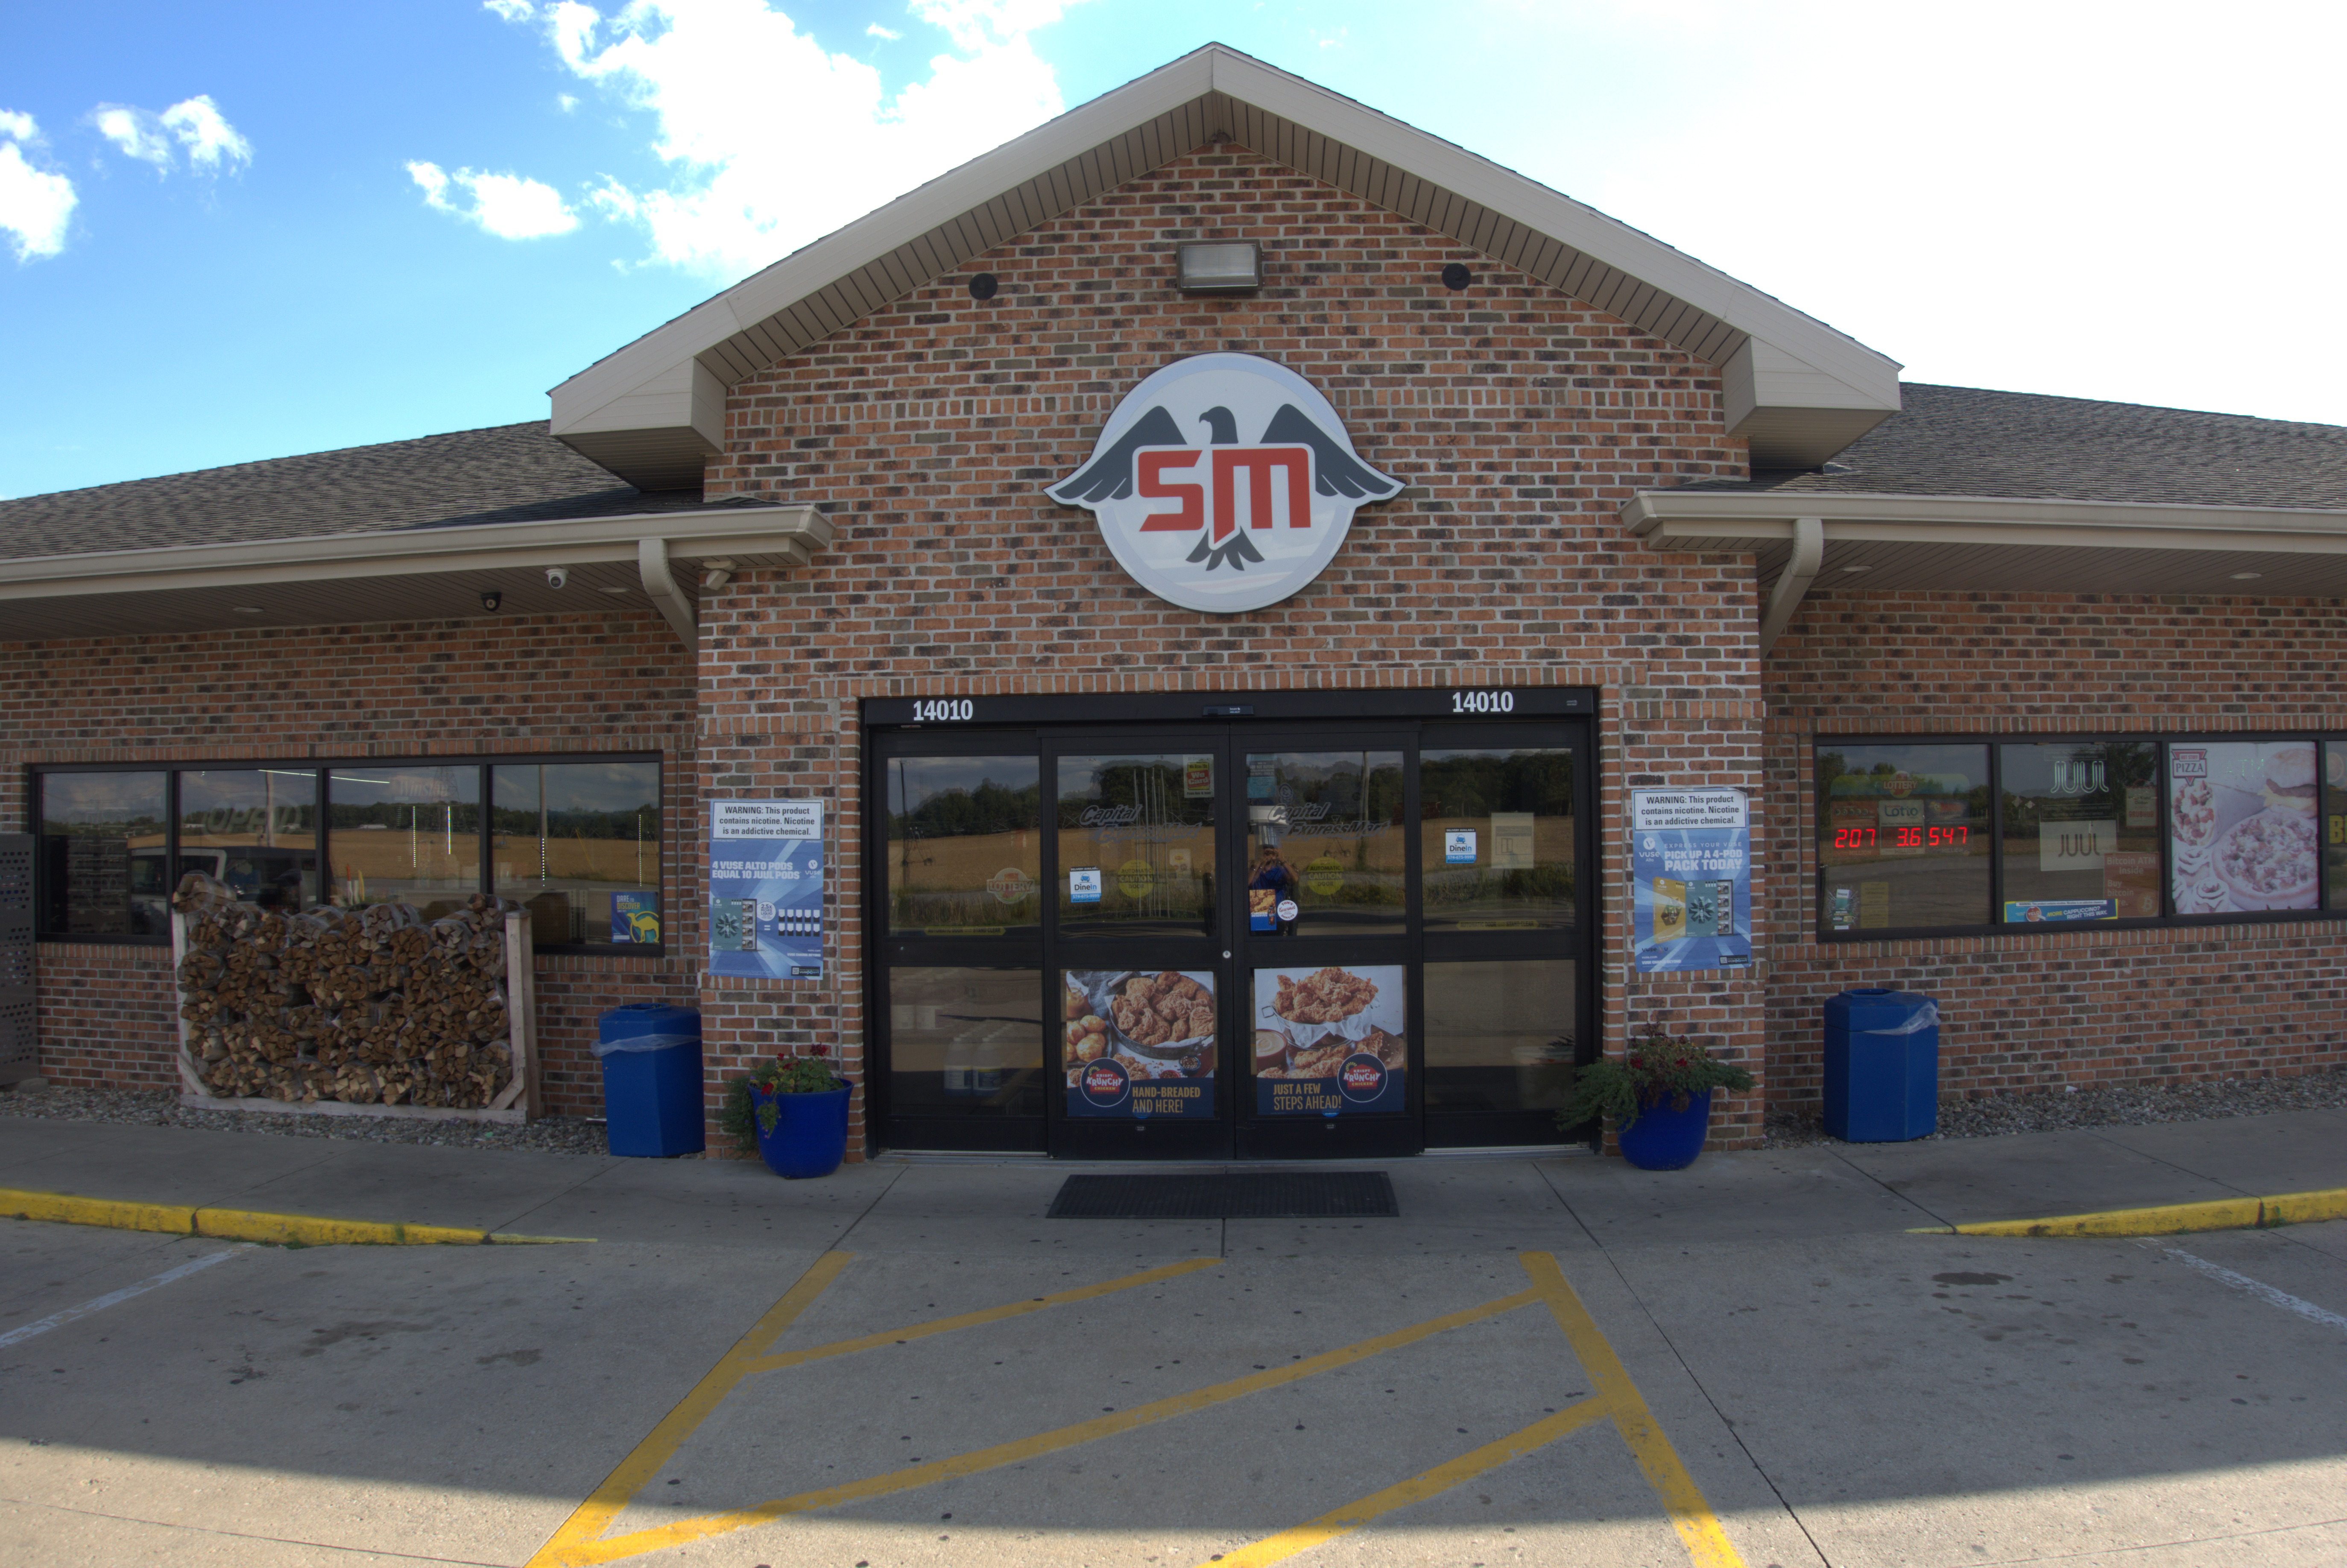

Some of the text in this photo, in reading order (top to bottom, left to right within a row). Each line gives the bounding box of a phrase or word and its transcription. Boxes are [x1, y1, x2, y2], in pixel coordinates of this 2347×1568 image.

[1138, 448, 1311, 544] SM
[1453, 691, 1513, 712] 14010
[914, 699, 973, 720] 14010
[2176, 763, 2204, 772] PIZZA
[1188, 777, 1209, 785] Card
[2050, 761, 2109, 793] JUUL
[1883, 779, 1918, 790] LOTTERY
[1706, 795, 1734, 804] product
[782, 807, 810, 816] product
[1080, 804, 1143, 825] Capital
[1268, 802, 1332, 823] Capital
[1885, 805, 1919, 817] Lotto
[1282, 820, 1391, 841] ExpressMart
[1929, 827, 1967, 845] 547
[1835, 829, 1876, 848] 207
[1896, 828, 1921, 846] 3.6
[2058, 834, 2100, 857] JUUL
[1664, 849, 1743, 860] PICK UP A 4-POD
[2107, 856, 2156, 865] Bitcoin ATM
[712, 861, 793, 870] 4 VUSE ALTO PODS
[1664, 858, 1743, 872] PACK TODAY
[2119, 866, 2144, 875] Inside
[712, 869, 740, 879] EQUAL
[742, 870, 752, 878] 10
[753, 870, 775, 879] JUUL
[989, 881, 1033, 891] LOTTERY
[2107, 879, 2122, 890] Buy
[2107, 889, 2134, 898] bitcoin
[2063, 906, 2101, 915] CAPPUCCINO?
[1086, 1076, 1124, 1087] KRUNCHY
[1343, 1072, 1381, 1083] KRUNCHY
[1132, 1086, 1201, 1098] HAND-BREADED
[1273, 1083, 1321, 1095] JUST A FEW
[1132, 1099, 1183, 1113] AND HERE!
[1274, 1094, 1342, 1111] STEPS AHEAD!
